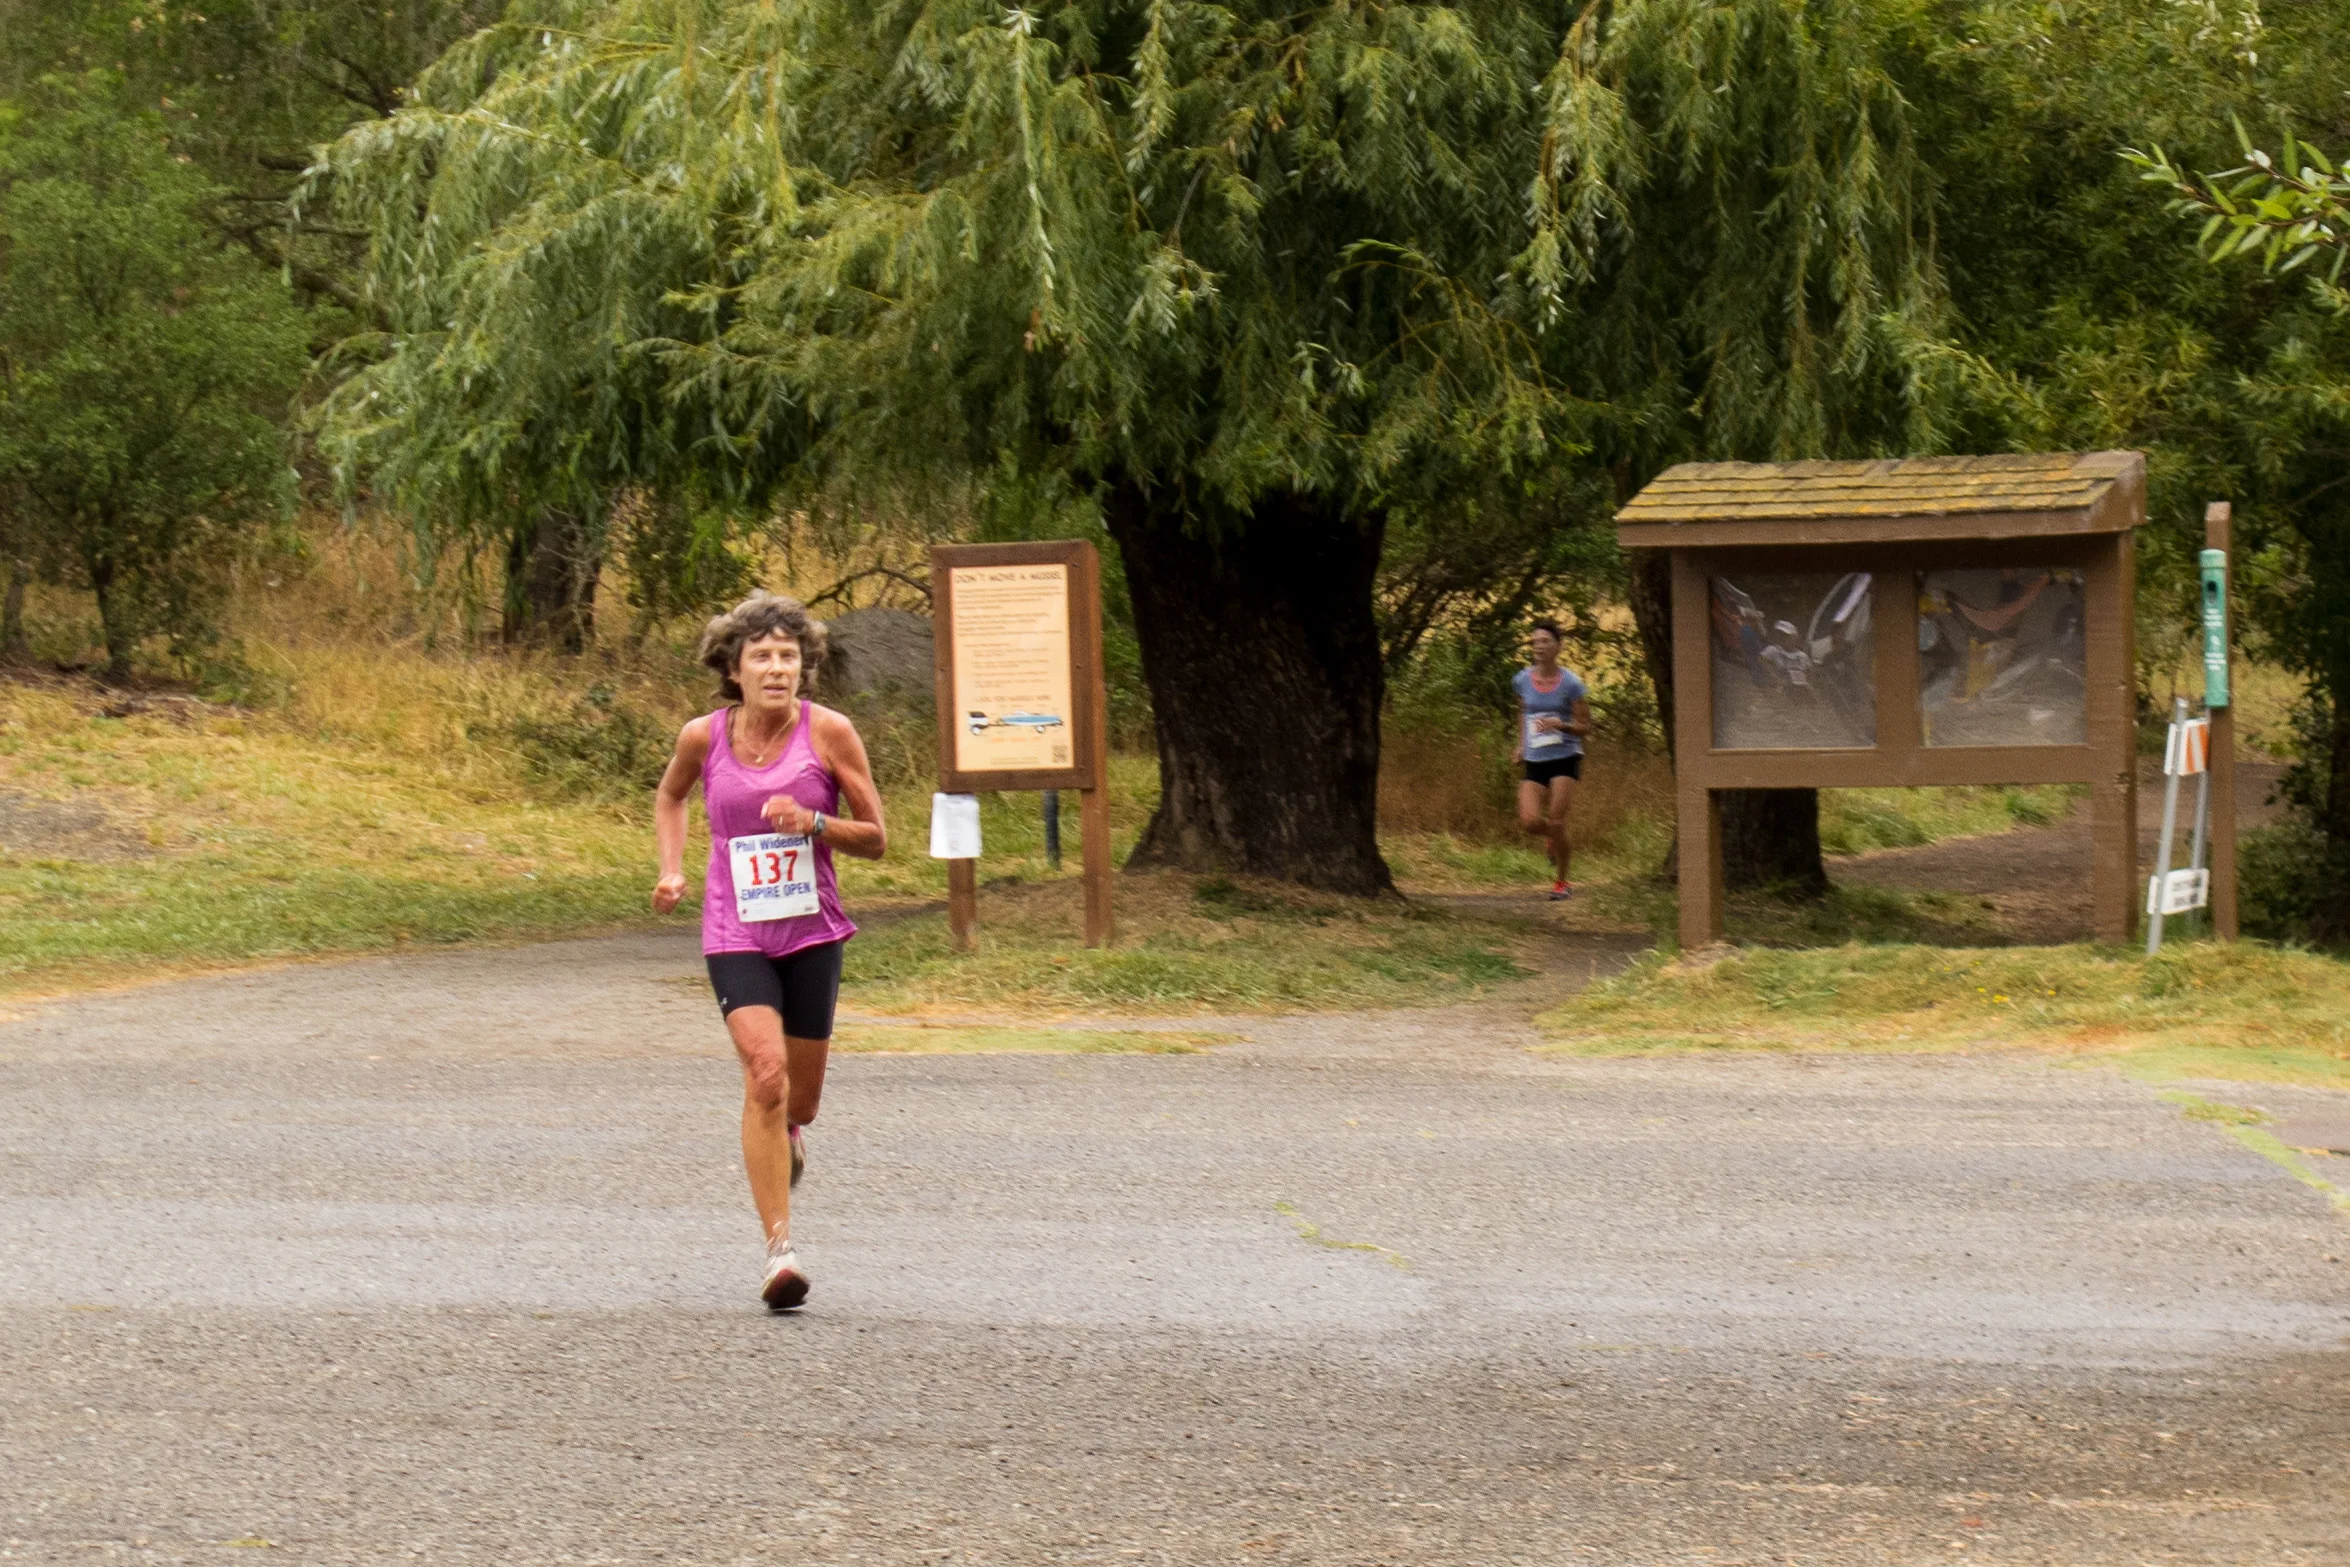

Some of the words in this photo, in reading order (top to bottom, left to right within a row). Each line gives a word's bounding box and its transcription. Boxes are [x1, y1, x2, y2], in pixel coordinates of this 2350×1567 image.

[736, 840, 755, 852] Phil
[749, 849, 798, 886] 137
[741, 885, 780, 900] EMPIRE
[783, 882, 811, 897] OPEN
